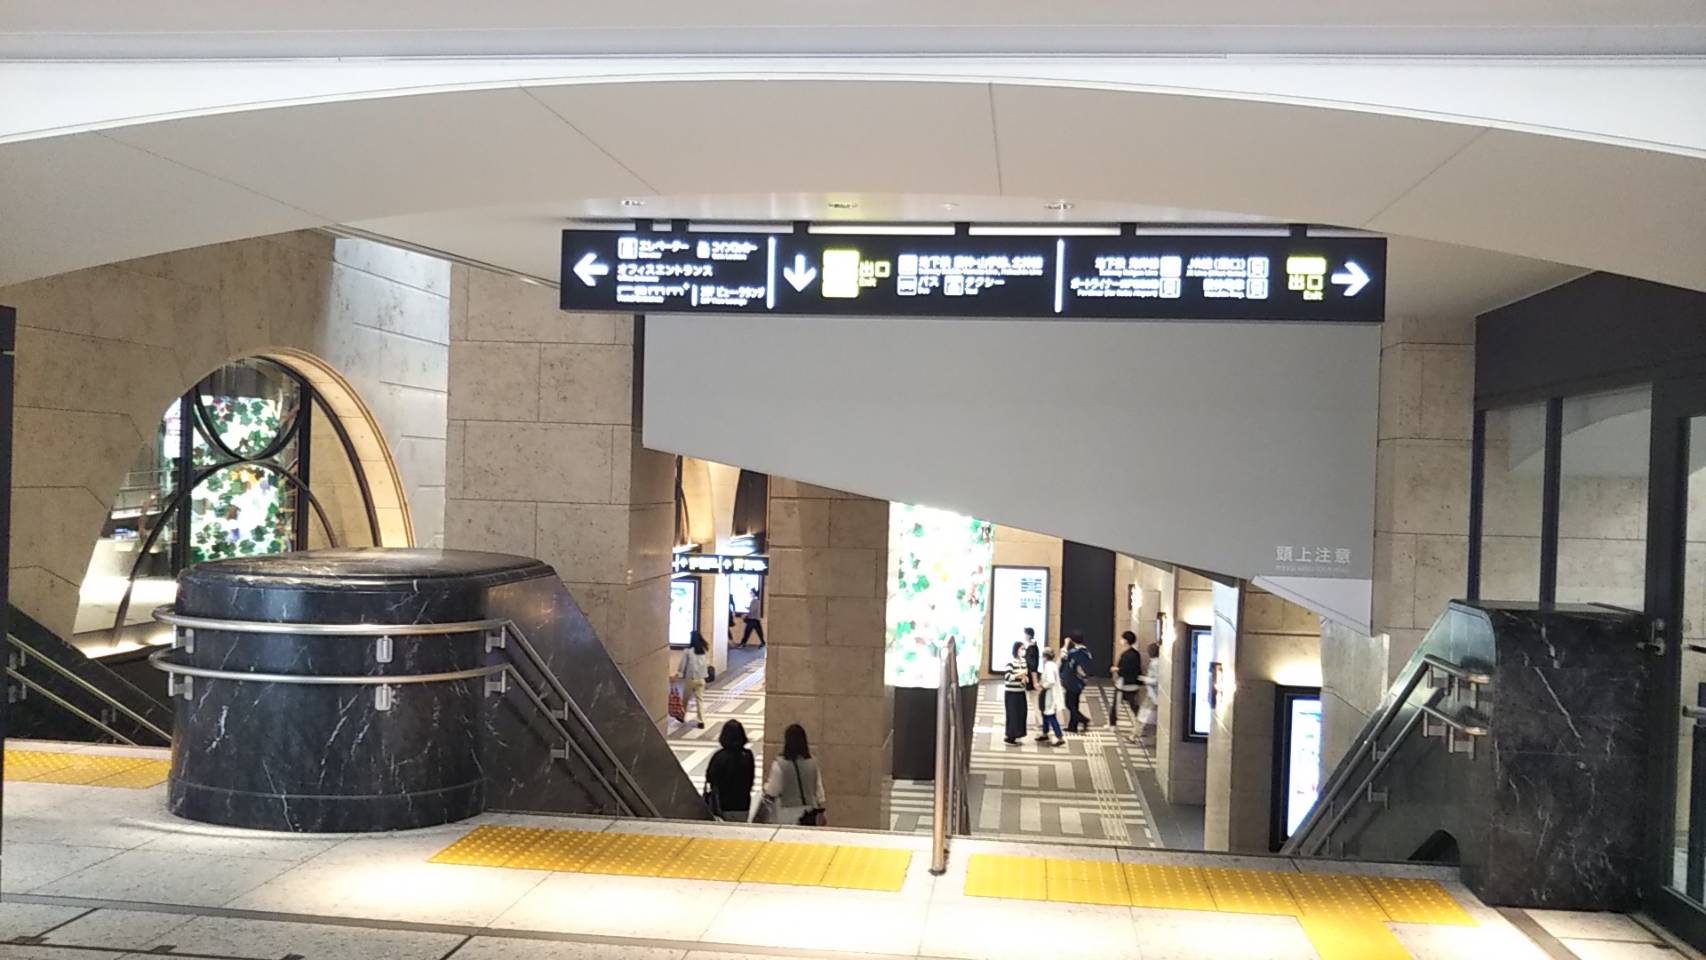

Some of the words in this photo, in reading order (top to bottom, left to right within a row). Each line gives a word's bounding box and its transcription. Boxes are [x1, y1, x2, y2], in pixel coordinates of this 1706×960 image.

[859, 260, 890, 277] 出口
[919, 276, 939, 287] バス
[965, 277, 1005, 288] タクシー
[1289, 274, 1323, 290] 出口
[1276, 546, 1352, 564] 頭上注意
